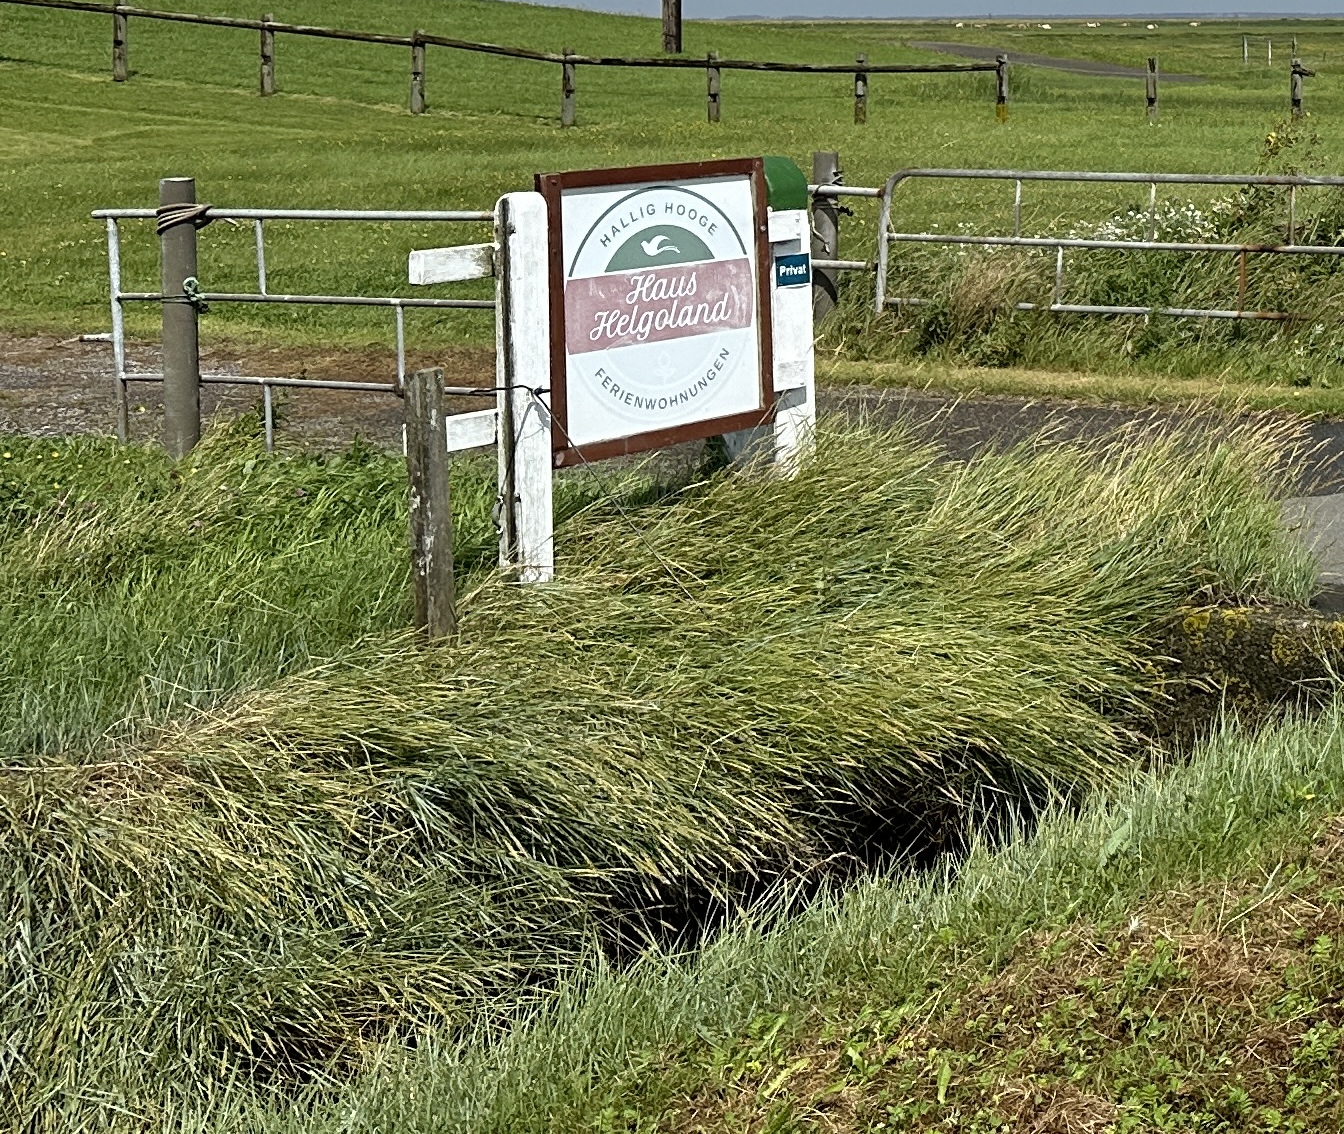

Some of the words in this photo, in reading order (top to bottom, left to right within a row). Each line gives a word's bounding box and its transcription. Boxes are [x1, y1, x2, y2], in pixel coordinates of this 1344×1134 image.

[600, 203, 656, 247] HALLIG
[665, 202, 718, 236] HOOGE
[625, 271, 697, 304] Haus
[780, 264, 807, 277] Privat
[589, 292, 732, 341] Helgoland
[594, 347, 730, 410] FERIENWOHNUNGEN
